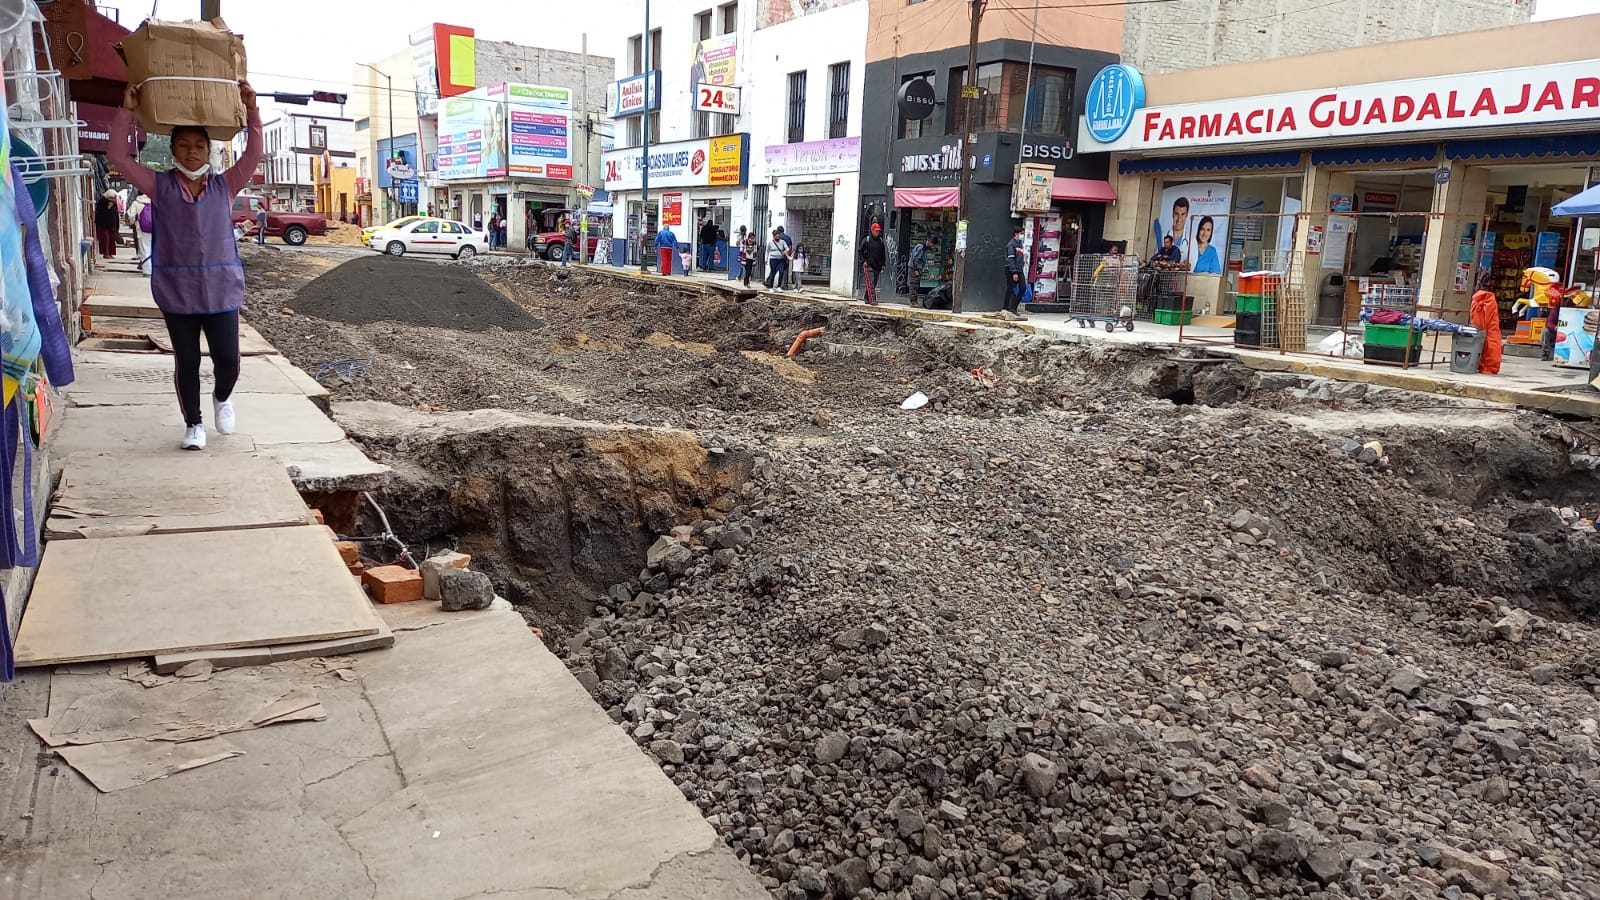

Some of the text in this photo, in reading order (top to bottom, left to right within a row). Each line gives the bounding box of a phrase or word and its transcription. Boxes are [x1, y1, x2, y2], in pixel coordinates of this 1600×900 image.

[701, 88, 724, 108] 24
[1143, 106, 1297, 141] FARMACIA
[605, 160, 617, 182] 24
[635, 154, 661, 171] FARACIAS
